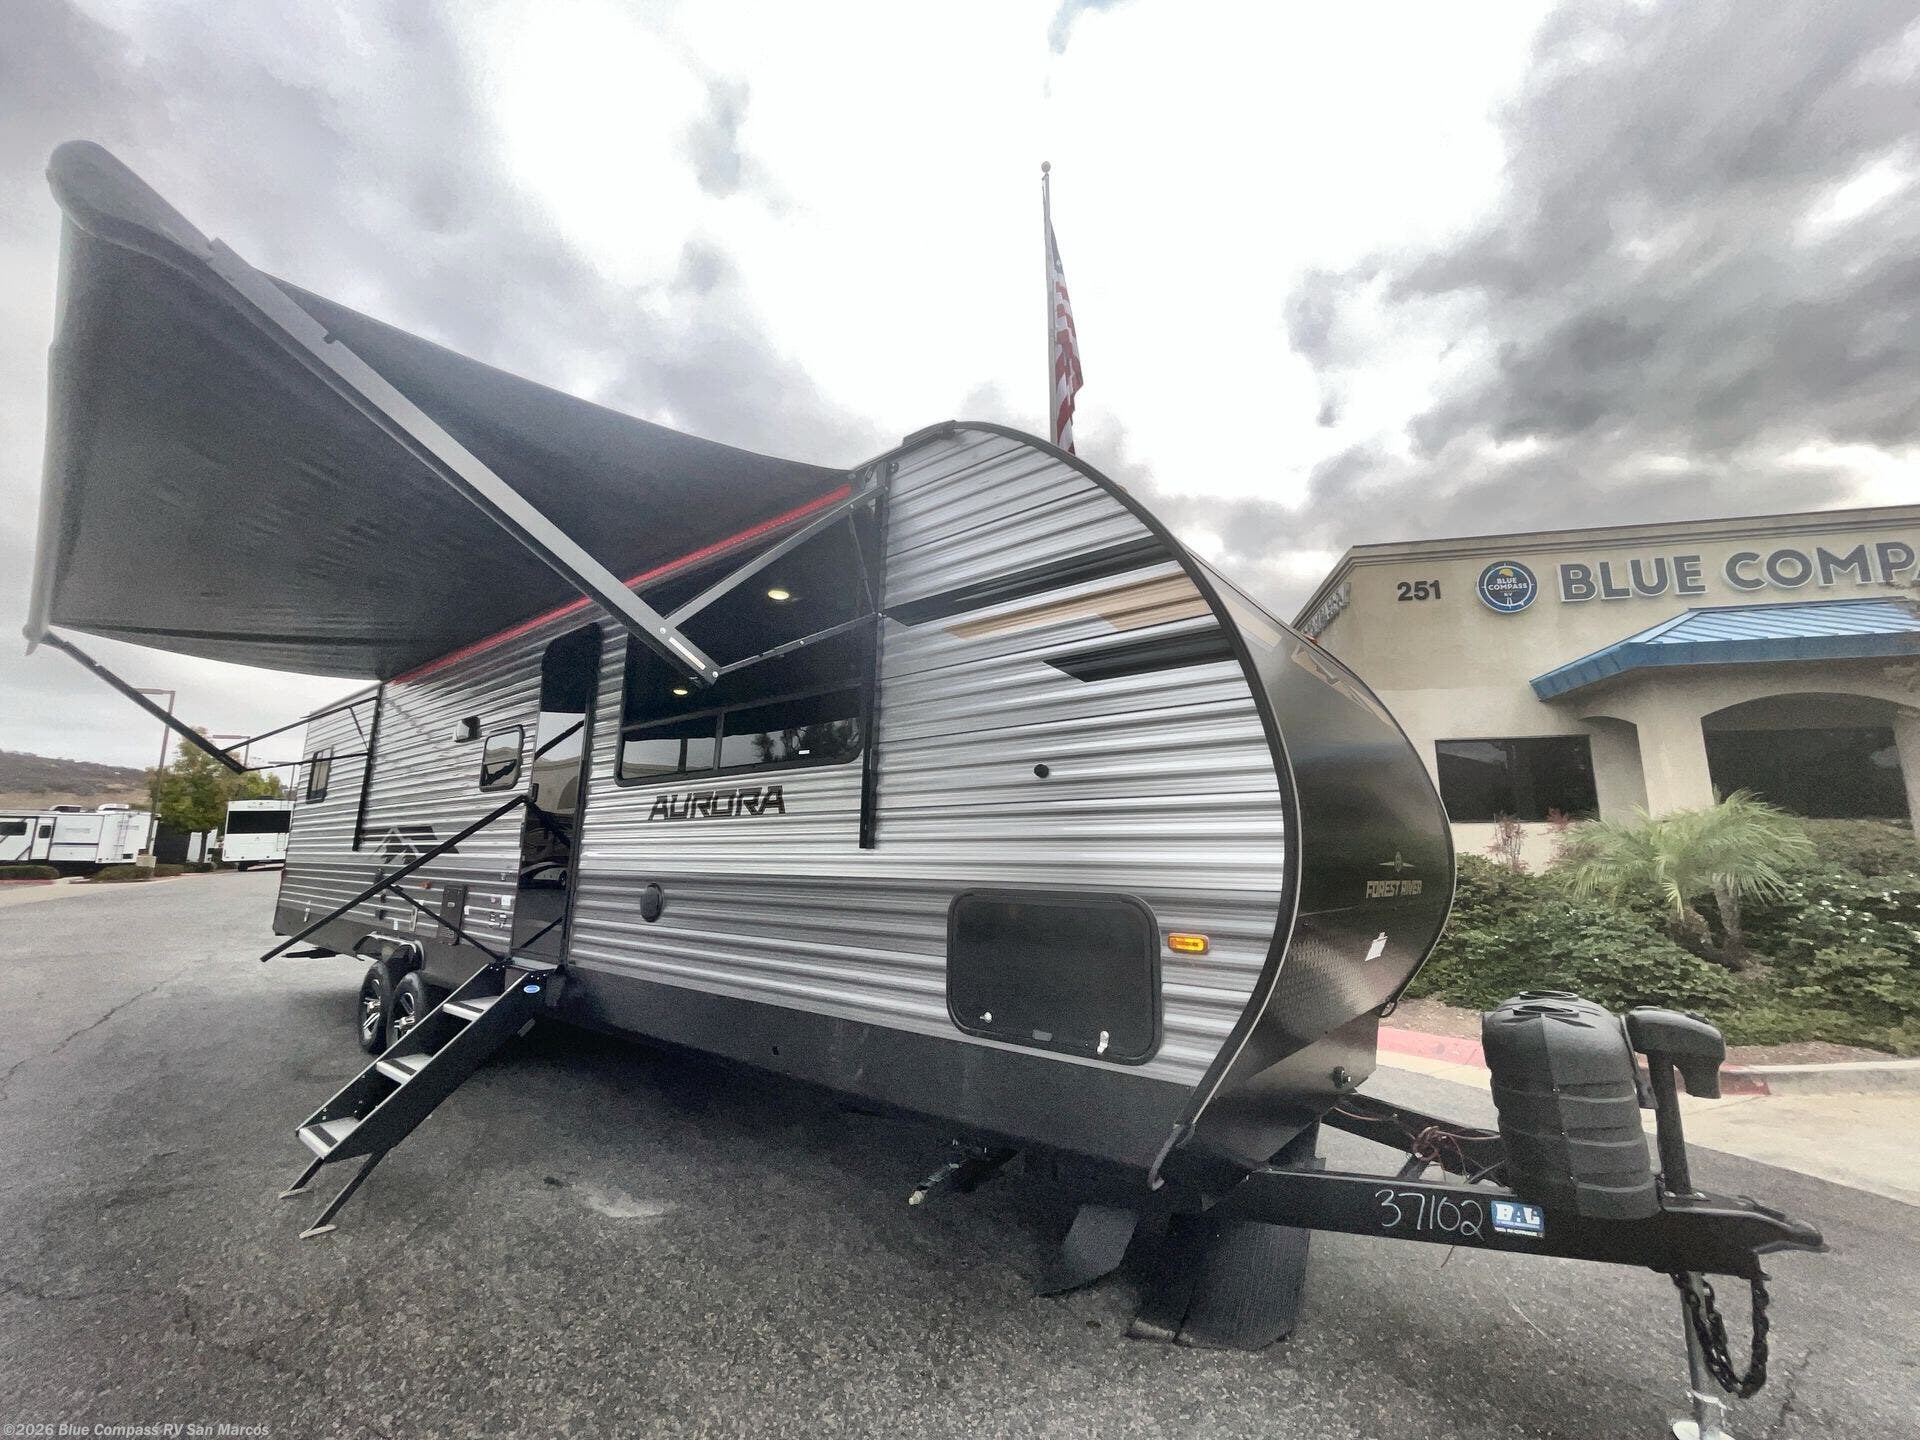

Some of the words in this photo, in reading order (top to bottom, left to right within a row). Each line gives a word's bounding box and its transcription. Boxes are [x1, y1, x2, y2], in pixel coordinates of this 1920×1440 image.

[1558, 554, 1707, 602] BLUE
[1724, 541, 1920, 590] COMP
[1397, 580, 1441, 602] 251
[1488, 583, 1528, 591] COMPASS
[648, 785, 786, 820] AURORA
[1366, 880, 1400, 898] FOREST
[1401, 880, 1422, 896] RIVER
[1375, 1189, 1485, 1241] 37102
